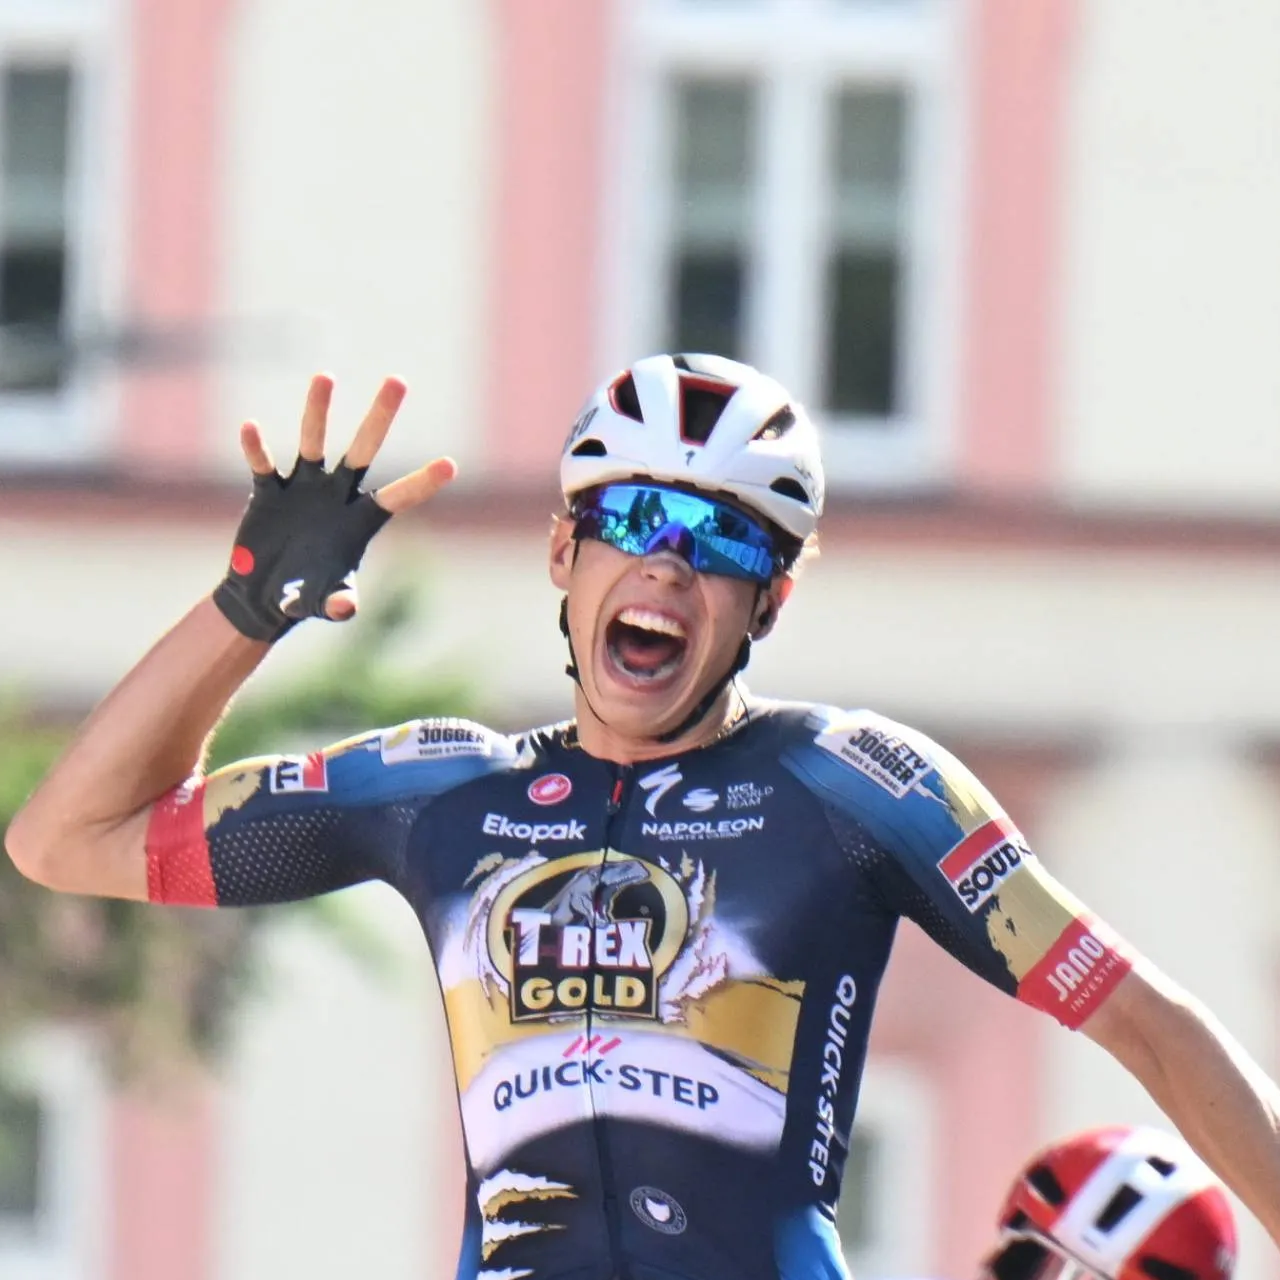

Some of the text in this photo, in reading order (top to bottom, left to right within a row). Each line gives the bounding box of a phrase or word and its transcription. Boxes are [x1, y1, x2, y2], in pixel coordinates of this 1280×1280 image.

[848, 728, 915, 786] JOGGER
[482, 813, 587, 844] Ekopak
[641, 816, 765, 836] NAPOLEON
[521, 974, 647, 1010] GOLD
